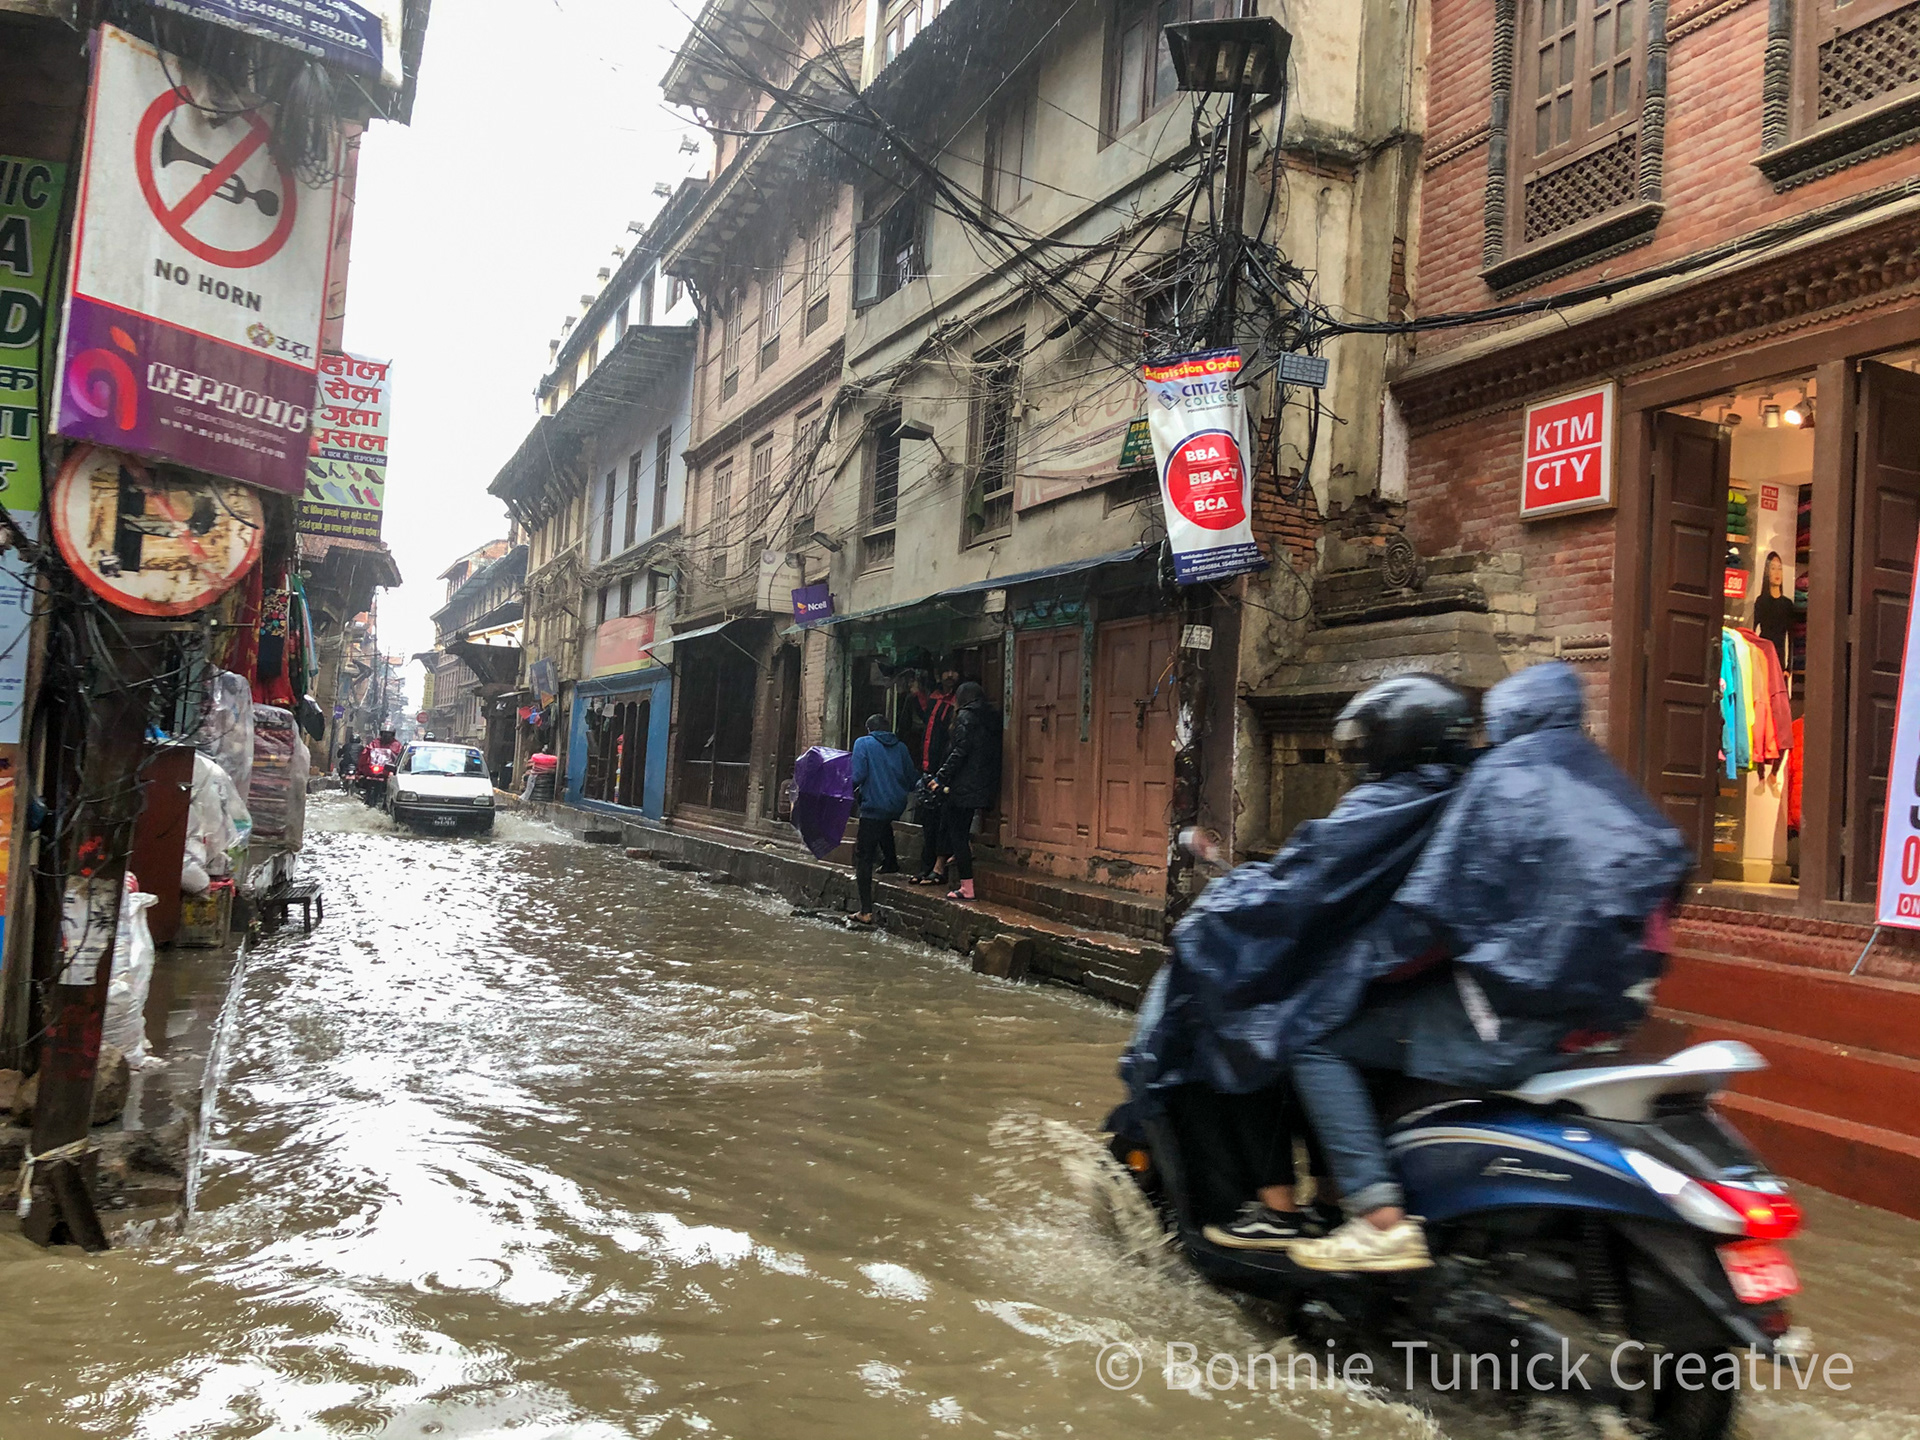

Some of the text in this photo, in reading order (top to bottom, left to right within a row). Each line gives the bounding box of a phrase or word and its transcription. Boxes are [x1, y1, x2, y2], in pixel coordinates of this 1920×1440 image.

[155, 258, 262, 312] NO HORN
[1145, 360, 1240, 380] Admission Open
[147, 361, 308, 433] NEPHOLIC
[324, 377, 382, 404] सेल
[1184, 393, 1239, 408] COLLEGE
[320, 404, 382, 427] जुता
[1535, 411, 1594, 452] KTM
[1185, 447, 1220, 462] BBA
[1534, 454, 1592, 490] CTY
[1194, 496, 1229, 512] BCA
[807, 600, 828, 611] Ncell
